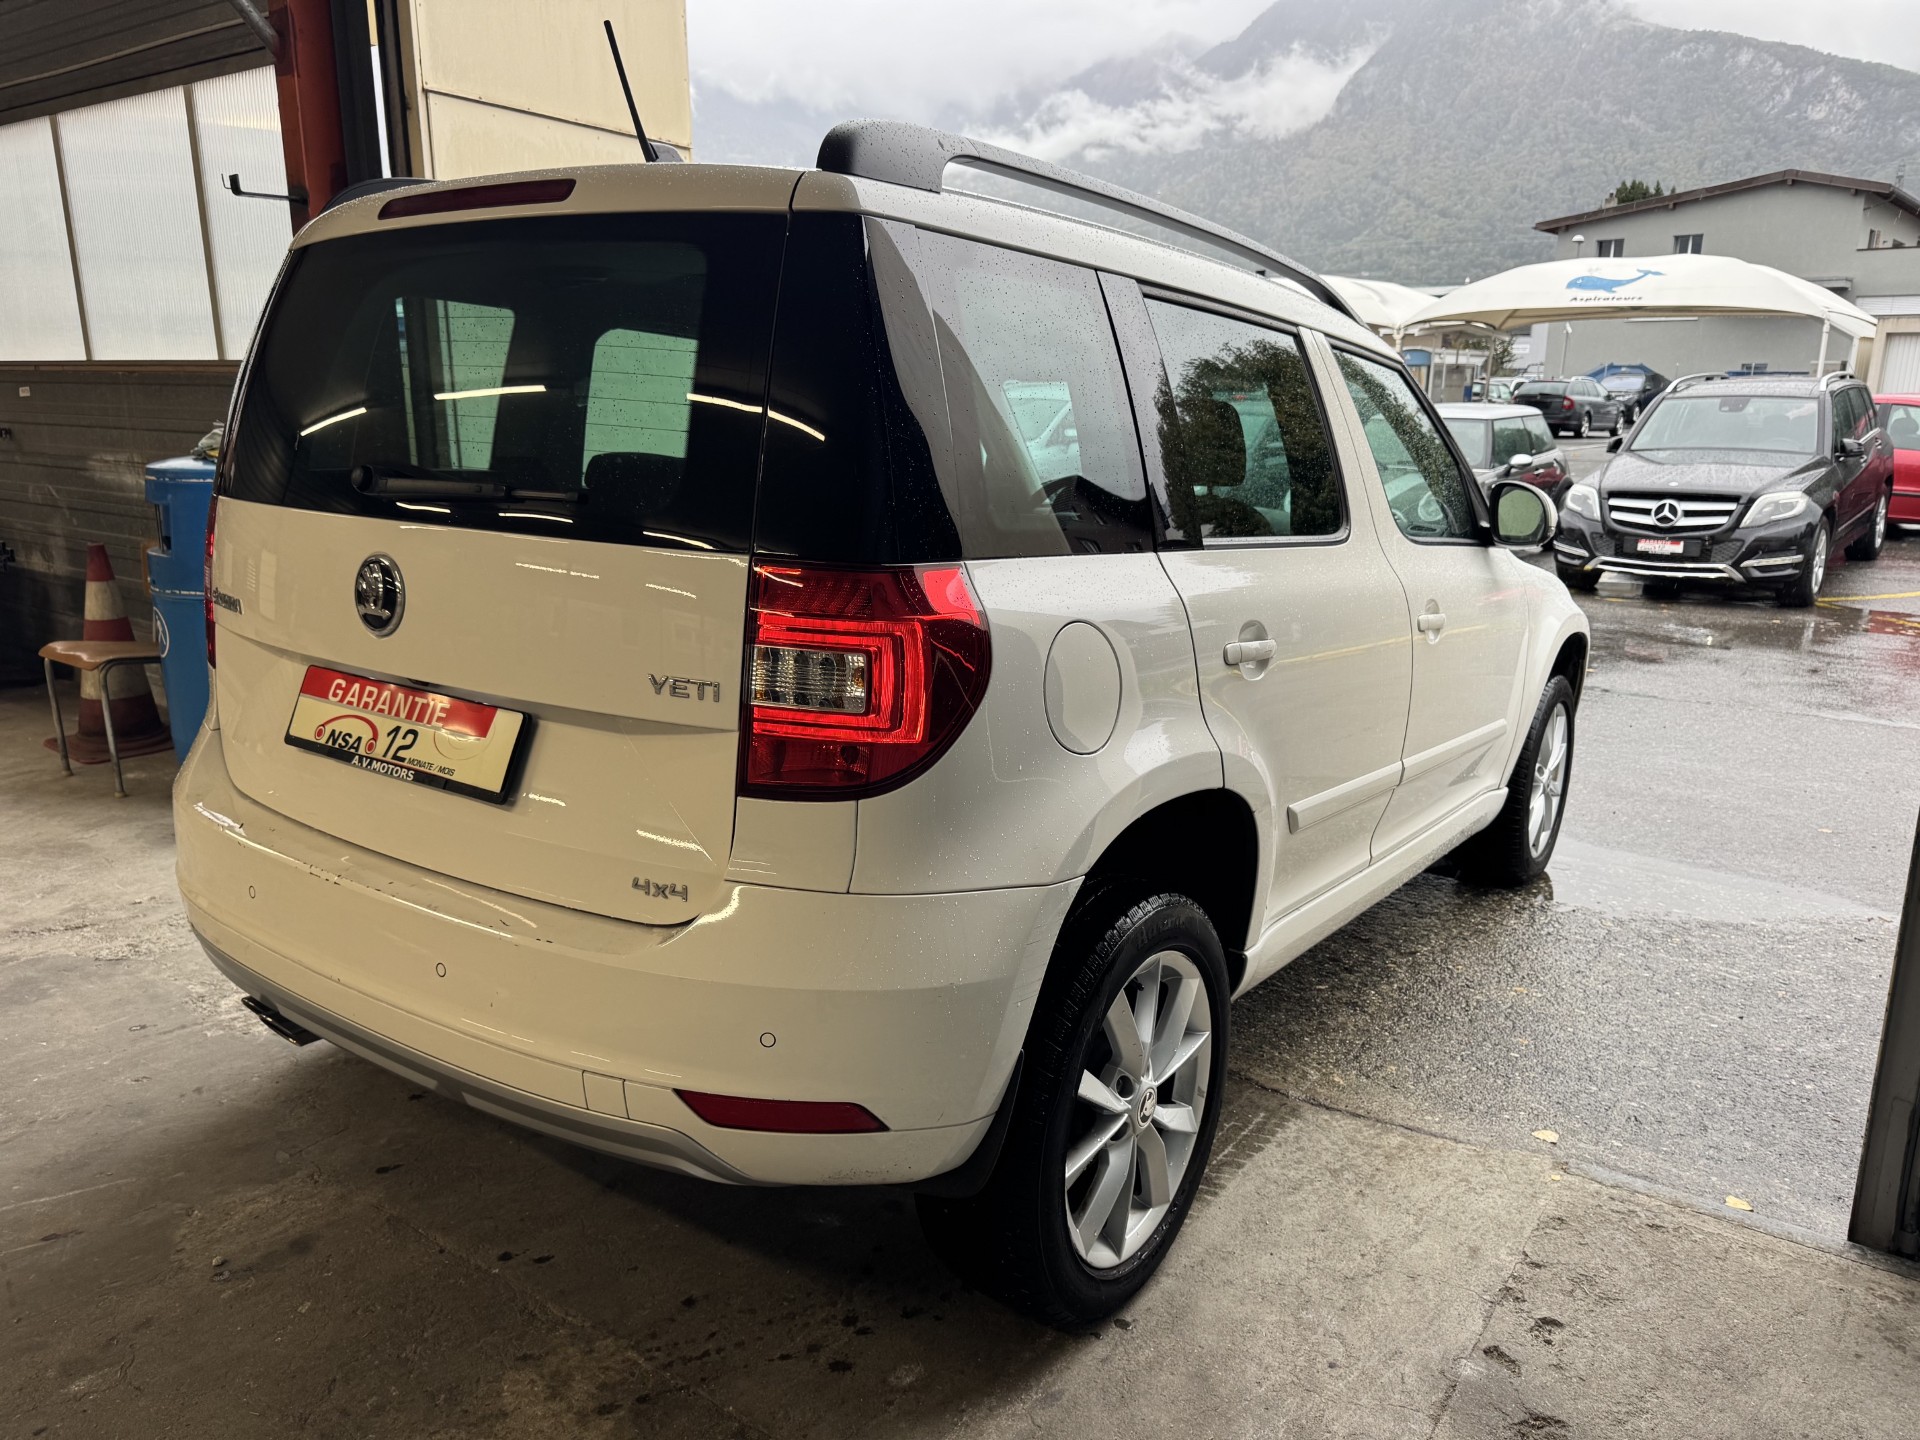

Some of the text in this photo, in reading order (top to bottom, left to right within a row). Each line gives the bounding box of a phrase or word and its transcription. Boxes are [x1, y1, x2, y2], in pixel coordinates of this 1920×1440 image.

[648, 673, 720, 702] YETI
[328, 679, 450, 727] GARANTIE
[325, 729, 362, 753] NSA
[382, 725, 419, 763] 12
[351, 755, 415, 781] A.V.MOTORS
[632, 877, 688, 902] 4x4
